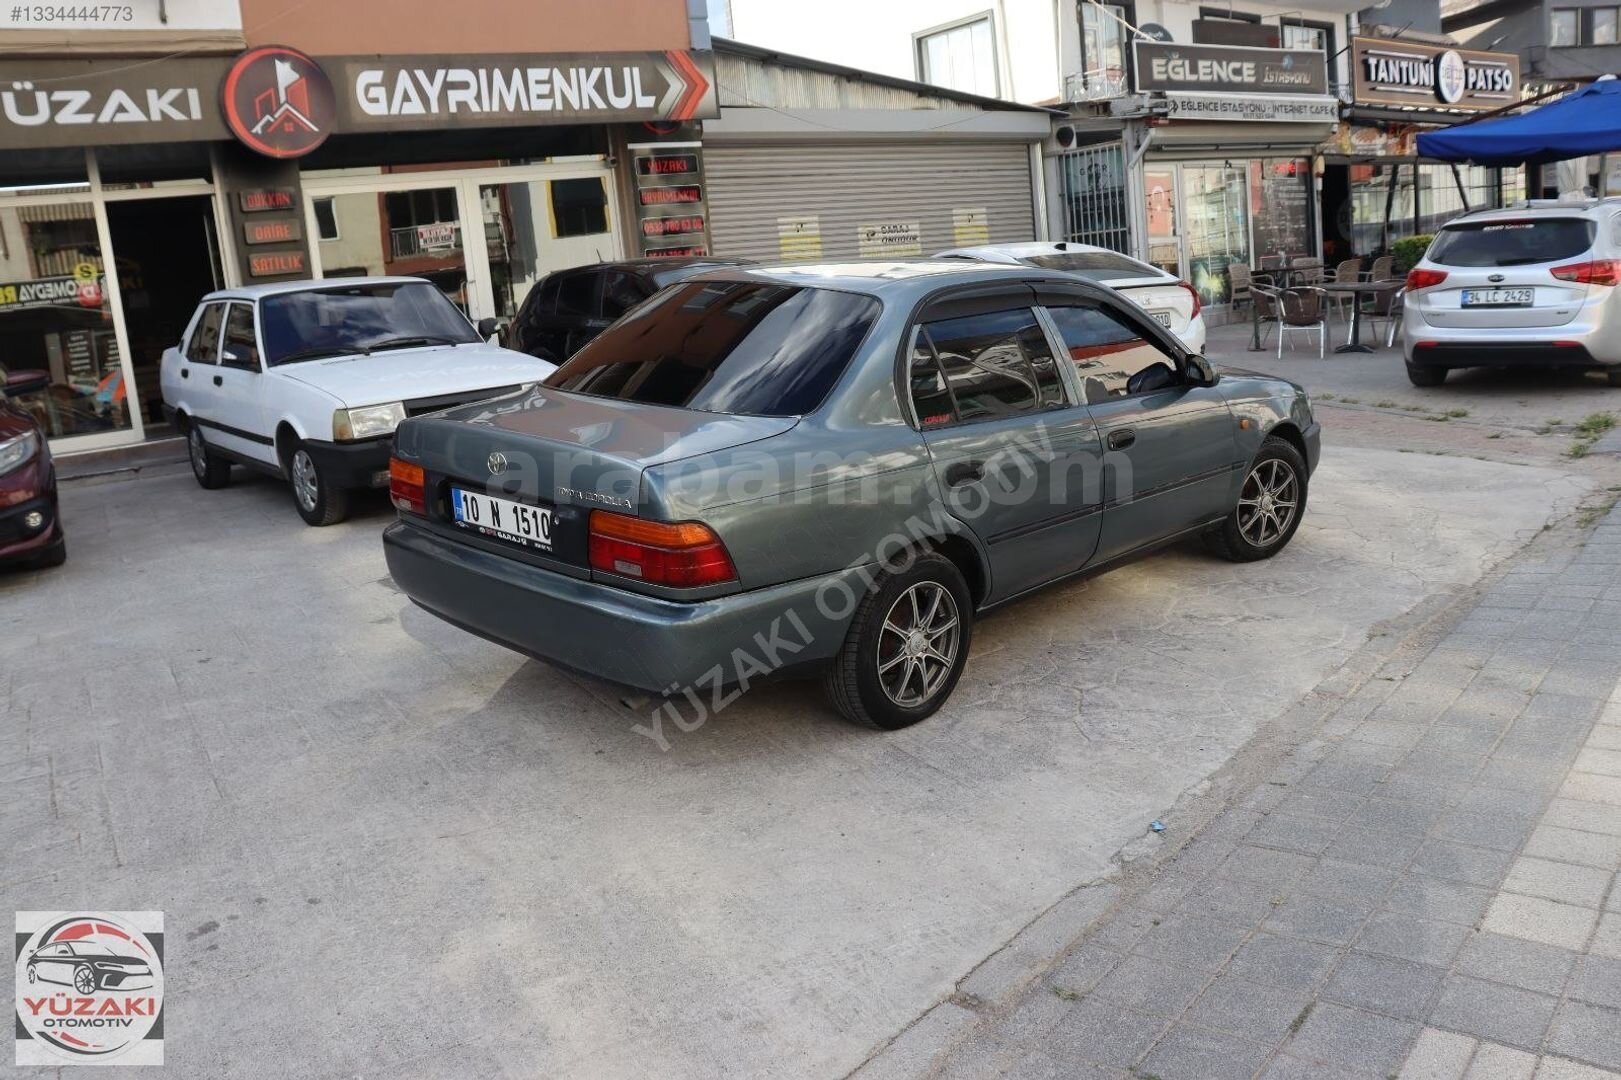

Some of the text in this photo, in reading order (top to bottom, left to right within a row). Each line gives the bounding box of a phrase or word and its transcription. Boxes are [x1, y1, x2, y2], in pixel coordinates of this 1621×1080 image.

[1151, 53, 1256, 83] EĞLENCE
[1367, 57, 1435, 87] TANTUNİ
[1467, 67, 1513, 91] PATSO
[355, 65, 657, 116] GAYRIMENKUL
[1468, 292, 1480, 303] 34
[1503, 290, 1532, 302] 2429
[462, 493, 551, 540] 10 N 1510
